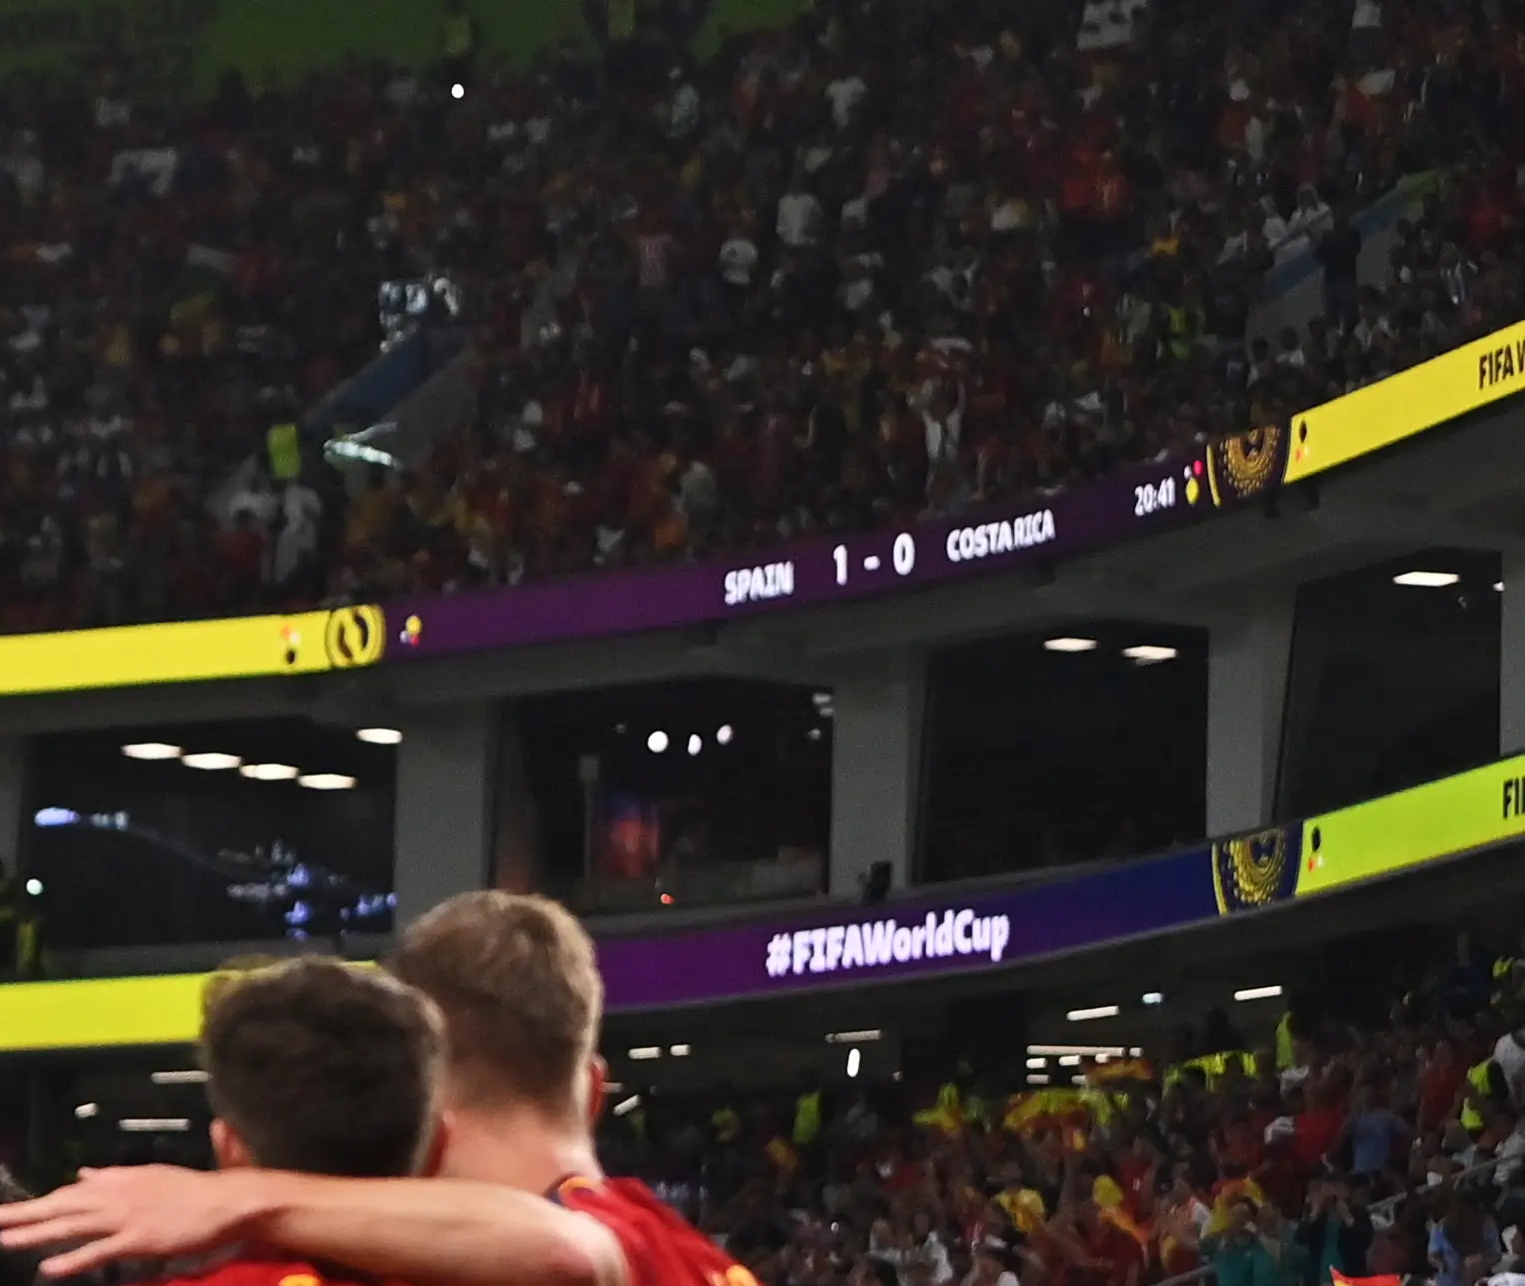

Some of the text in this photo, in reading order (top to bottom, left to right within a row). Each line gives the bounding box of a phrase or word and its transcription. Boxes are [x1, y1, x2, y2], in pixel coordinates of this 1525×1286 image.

[1479, 344, 1514, 390] FIFA
[724, 561, 794, 605] SPAIN
[833, 544, 848, 586] 1
[893, 532, 916, 576] 0
[947, 520, 1014, 563] COSTA
[1014, 509, 1056, 548] RICA
[1134, 476, 1176, 517] 20:41
[766, 908, 1010, 978] #FIFAWorldCup
